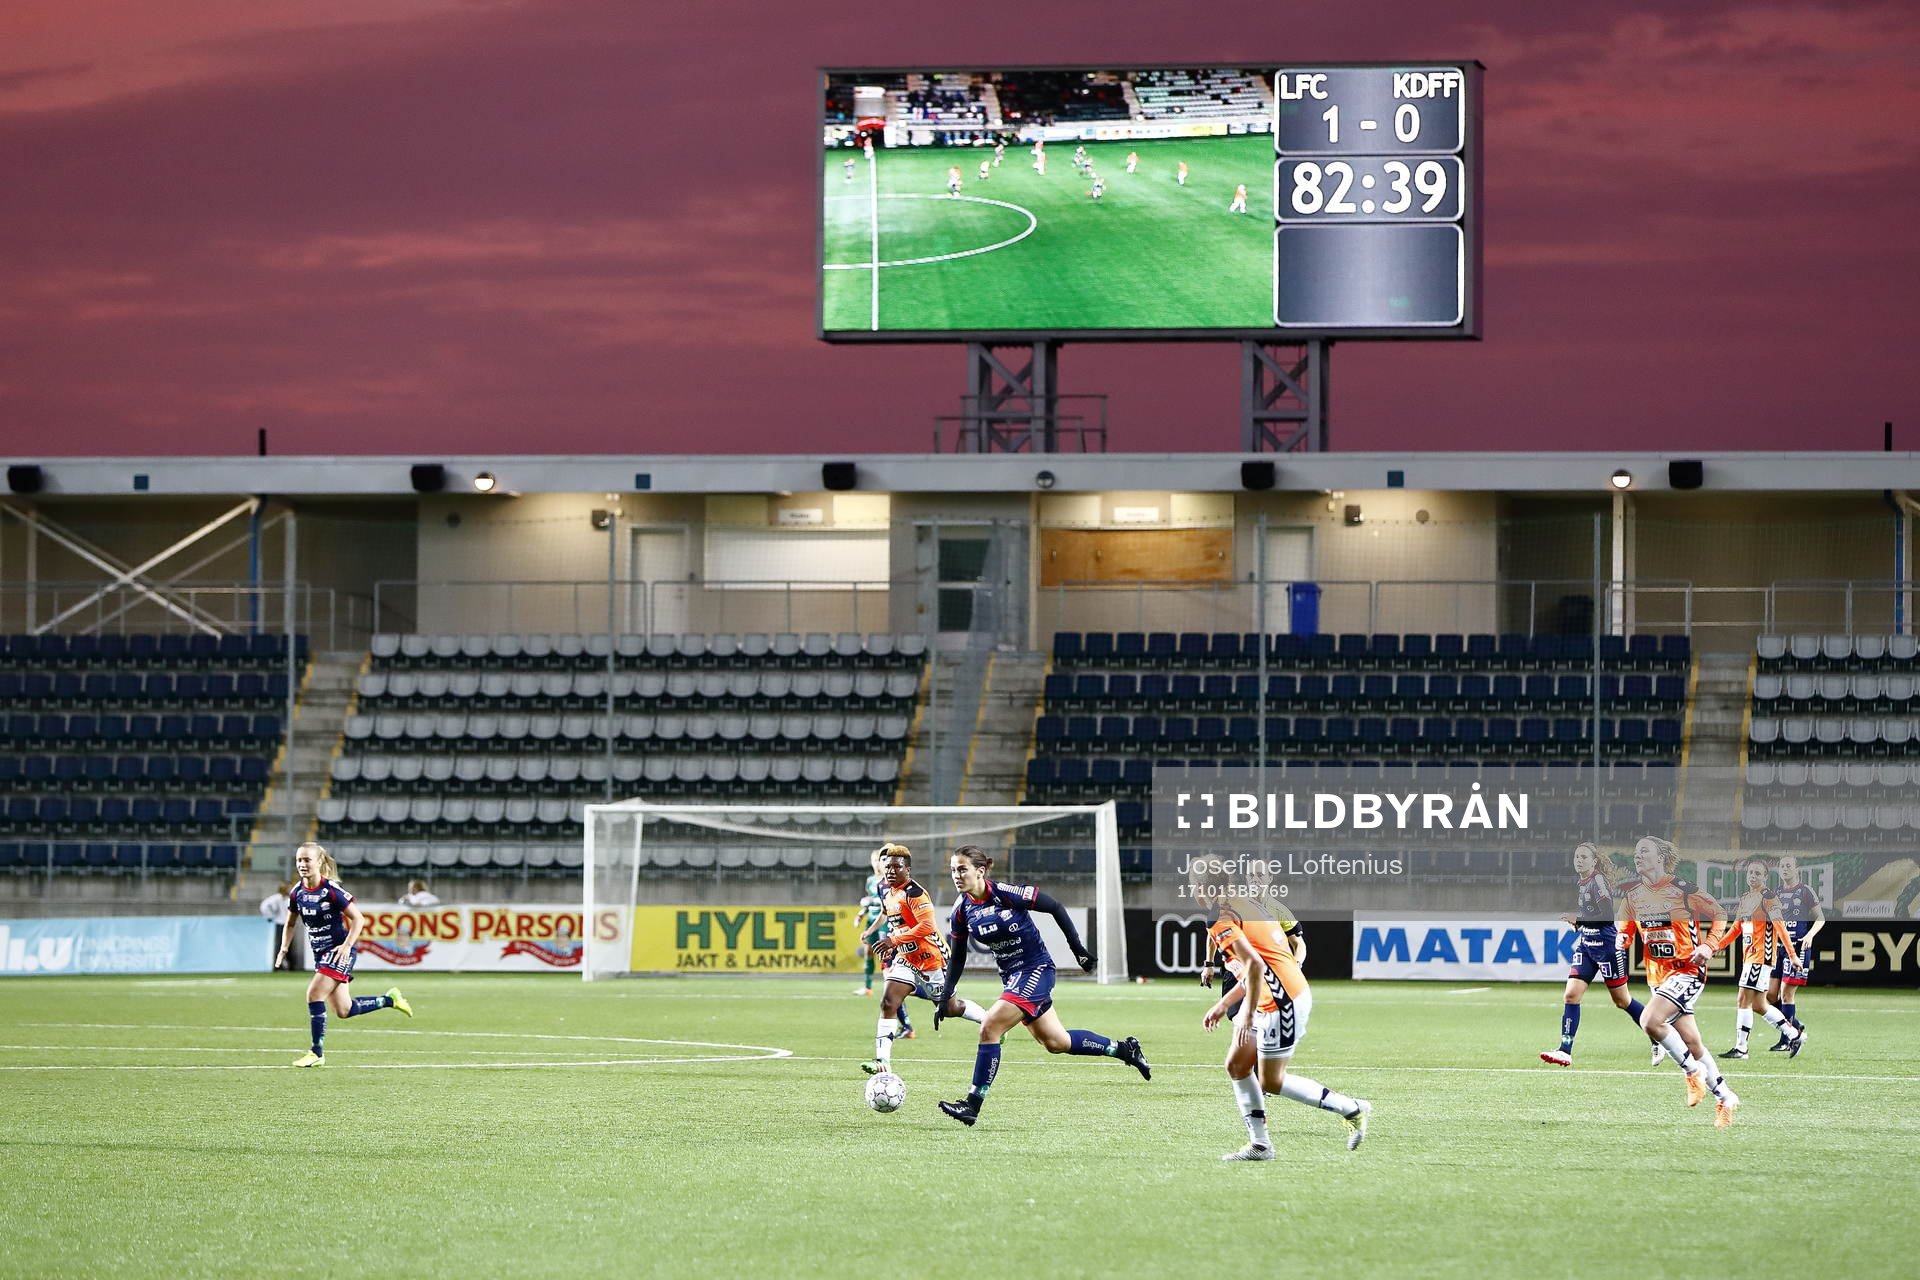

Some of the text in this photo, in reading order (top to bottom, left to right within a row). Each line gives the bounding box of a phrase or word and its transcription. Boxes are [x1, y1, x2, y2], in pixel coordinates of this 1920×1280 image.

[1280, 73, 1459, 99] LFC KDFF
[1322, 104, 1339, 143] 1
[1394, 103, 1420, 143] 0
[1291, 160, 1447, 214] 82:39
[346, 911, 460, 941] RSONS
[676, 911, 836, 949] HYLTE
[676, 954, 836, 968] JAKT & LANTMAN
